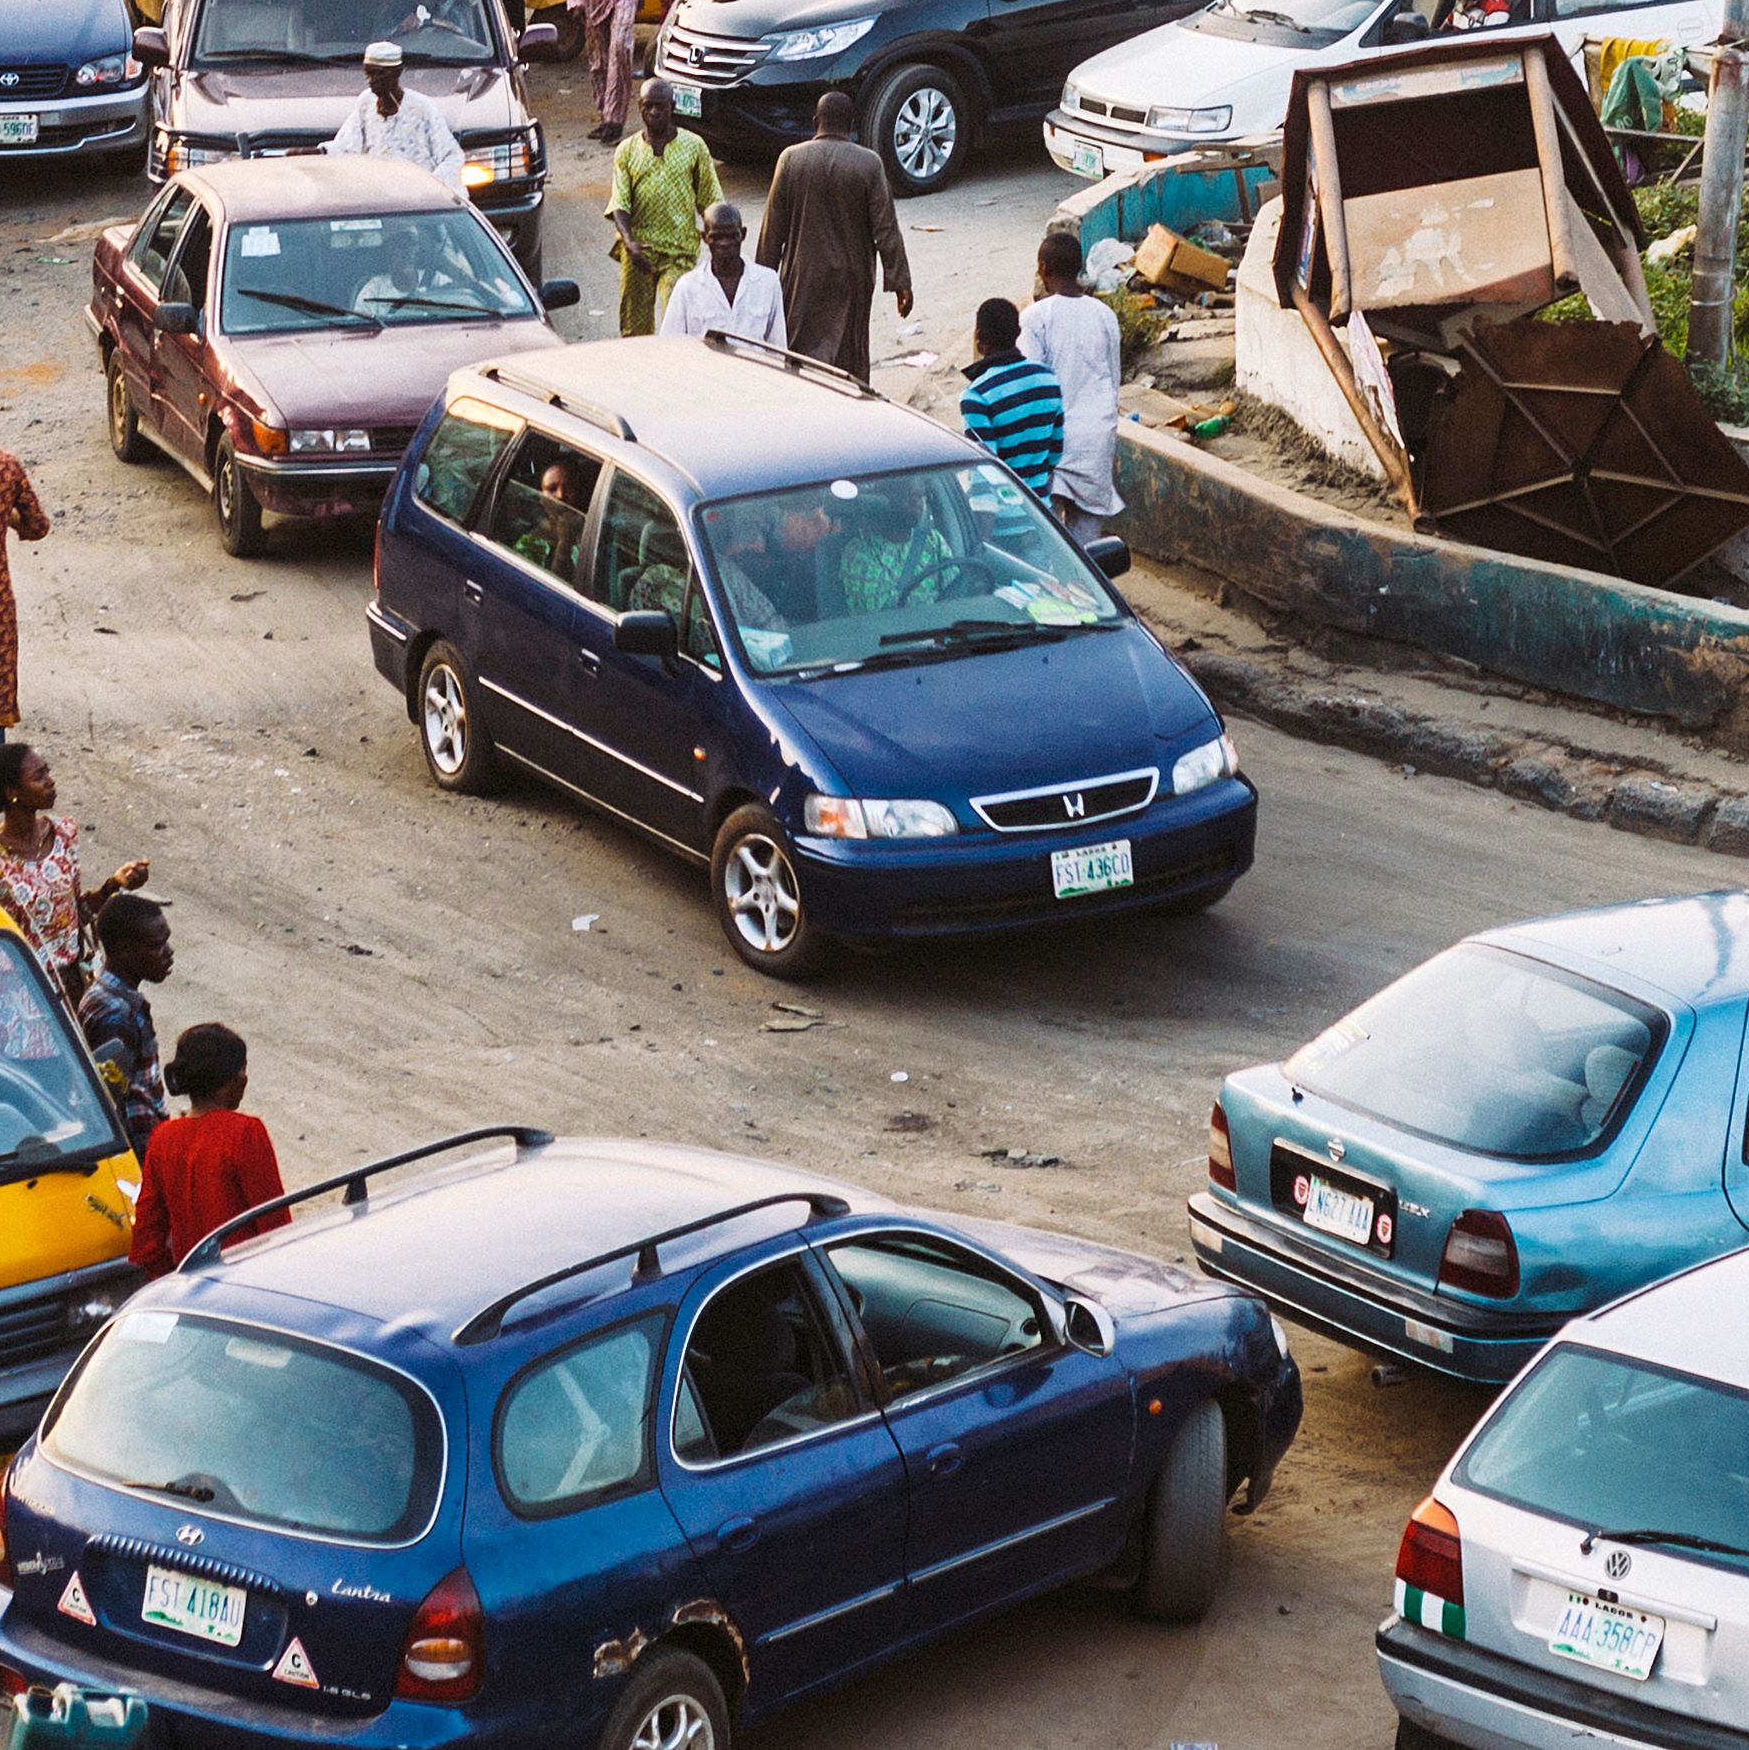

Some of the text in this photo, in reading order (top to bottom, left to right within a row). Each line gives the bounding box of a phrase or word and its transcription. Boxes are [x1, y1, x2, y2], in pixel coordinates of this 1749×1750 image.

[331, 1578, 391, 1603] Lantra
[1595, 1602, 1633, 1619] LAGOS
[291, 1653, 301, 1668] C
